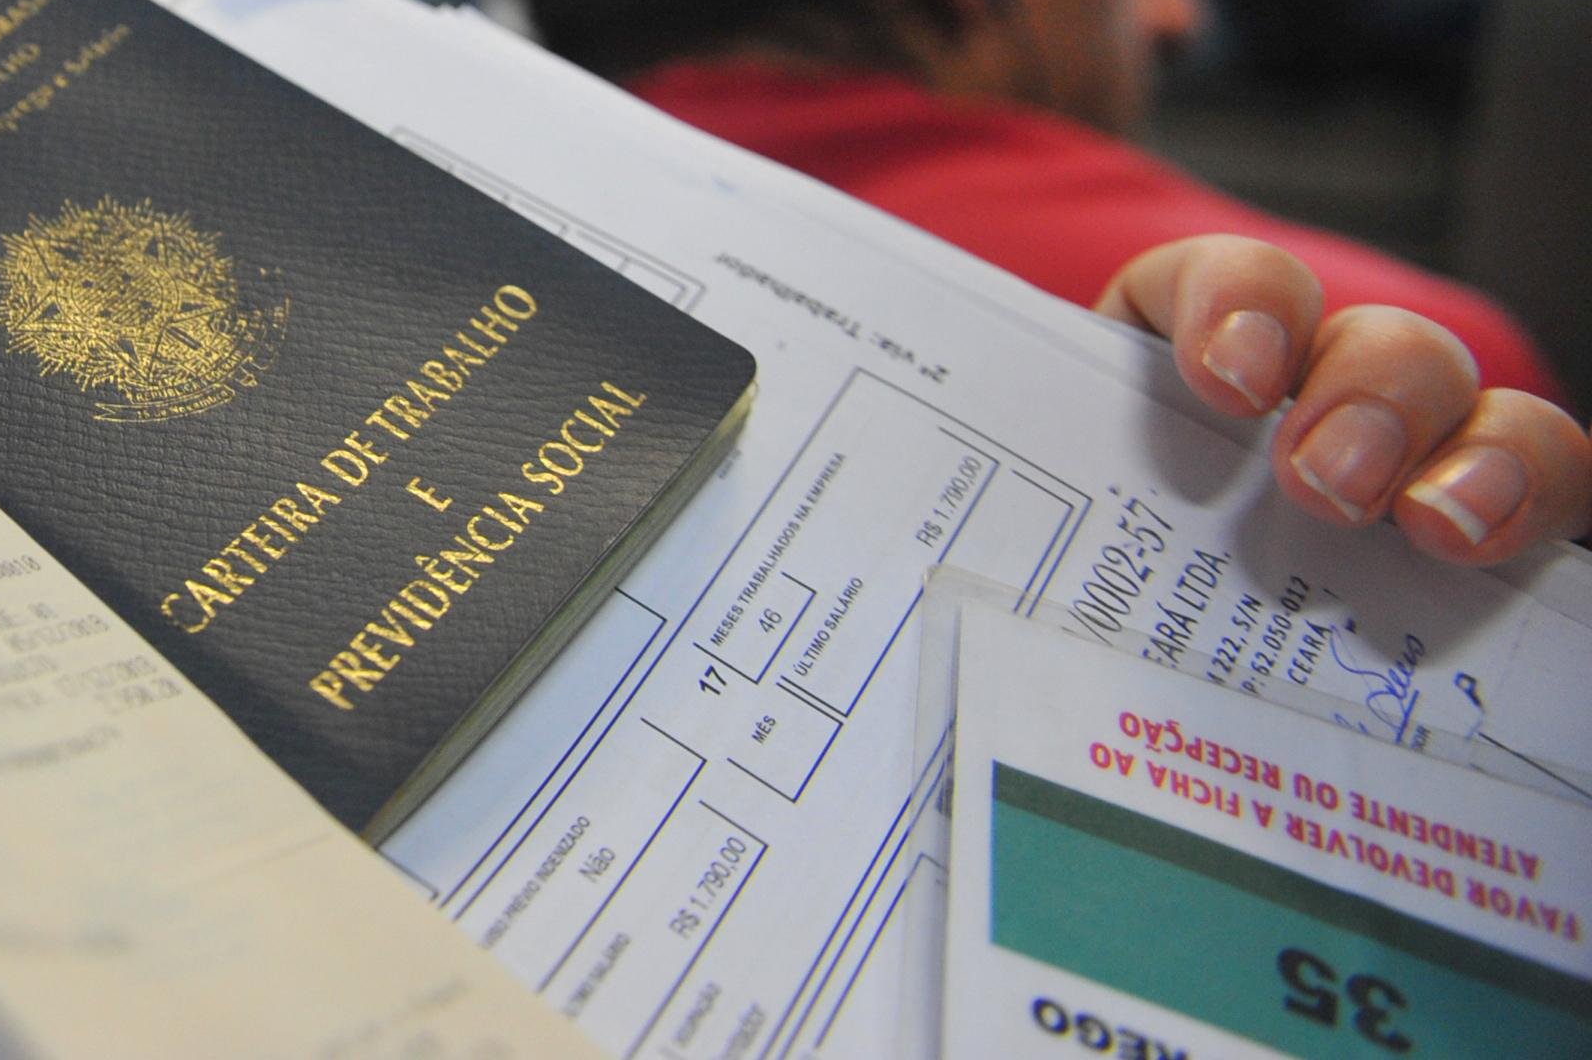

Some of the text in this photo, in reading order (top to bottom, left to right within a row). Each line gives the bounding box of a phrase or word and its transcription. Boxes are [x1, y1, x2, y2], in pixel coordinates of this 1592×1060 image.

[715, 253, 863, 339] Trabalhador
[161, 285, 538, 634] CARTEIRA DE TRABALHO
[407, 477, 453, 513] E
[916, 456, 982, 547] R$ 1.790,00
[311, 380, 647, 710] PREVIDÊNCIA SOCIAL
[711, 451, 847, 646] MESES TRABALHADOS NA EMPRESA
[1068, 497, 1176, 645] /0002-57
[1176, 549, 1233, 612] LTDA.
[760, 608, 783, 634] 46
[794, 577, 864, 677] ÚLTIMO SALÁRIO
[1231, 594, 1265, 632] S/N
[1253, 576, 1311, 676] 62.050-012
[699, 666, 728, 698] 17
[751, 714, 777, 745] MÊS
[1089, 741, 1581, 941] FAVOR DEVOLVER A FICHA AO
[1119, 711, 1540, 881] ATENDENTE OU RECEPÇÃO
[535, 815, 591, 883] INDENIZADO
[579, 845, 616, 883] Não
[669, 907, 702, 941] R$
[695, 836, 748, 913] 1.790,00
[1279, 950, 1413, 1052] 35
